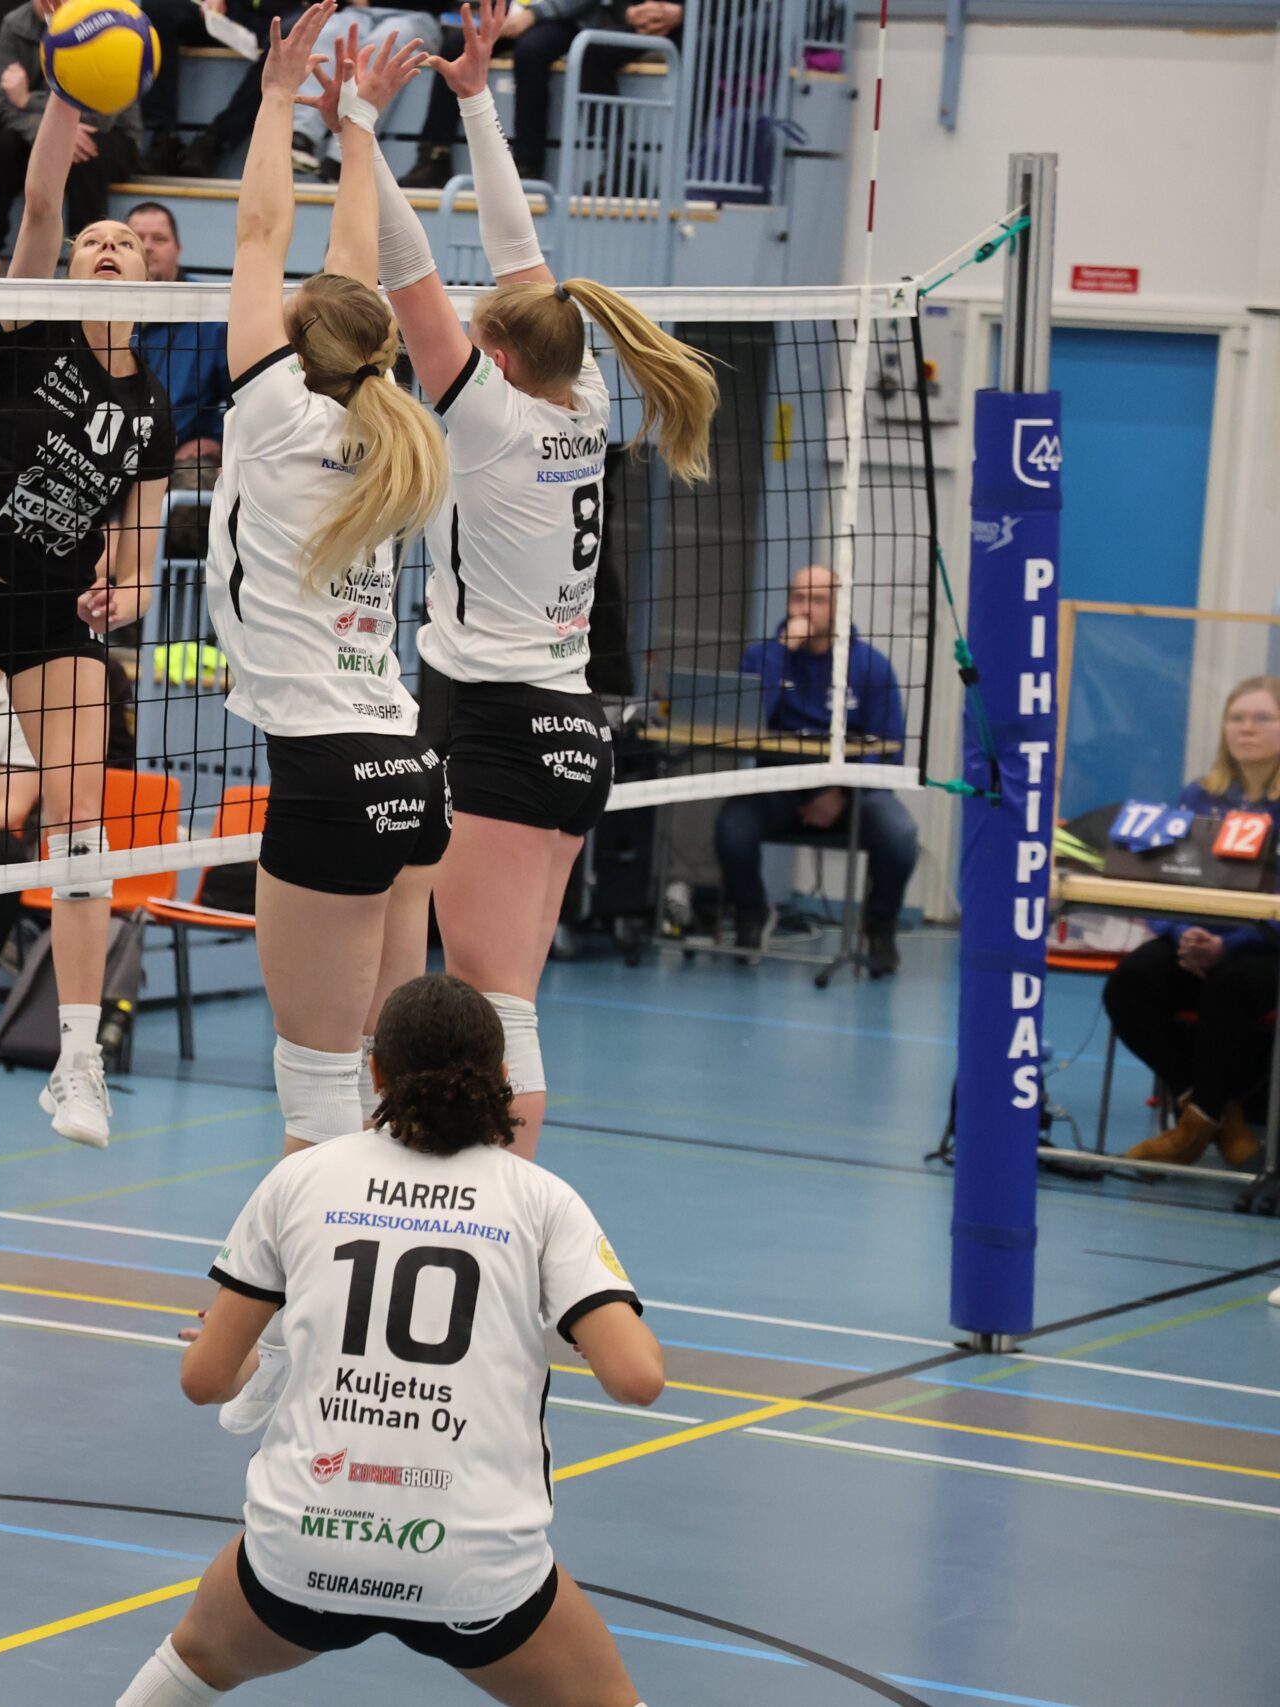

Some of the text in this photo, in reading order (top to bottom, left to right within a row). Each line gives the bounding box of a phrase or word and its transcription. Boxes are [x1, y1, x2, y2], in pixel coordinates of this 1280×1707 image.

[15, 494, 90, 532] KEITELE
[572, 482, 600, 572] 8
[541, 750, 598, 770] PUTAAN
[552, 763, 592, 784] Pizzeria
[365, 798, 425, 820] PUTAAN
[376, 814, 421, 834] Pizzeria
[1119, 804, 1163, 838] 17
[1221, 817, 1266, 853] 12
[366, 1177, 477, 1211] HARRIS
[324, 1210, 511, 1245] KESKISUOMALAINEN
[333, 1238, 481, 1366] 10
[335, 1366, 453, 1404] Kuljetus
[319, 1396, 468, 1442] Villman Oy
[304, 1505, 375, 1520] KESKI-SUOMEN
[307, 1570, 423, 1603] SEURASHOP.FI
